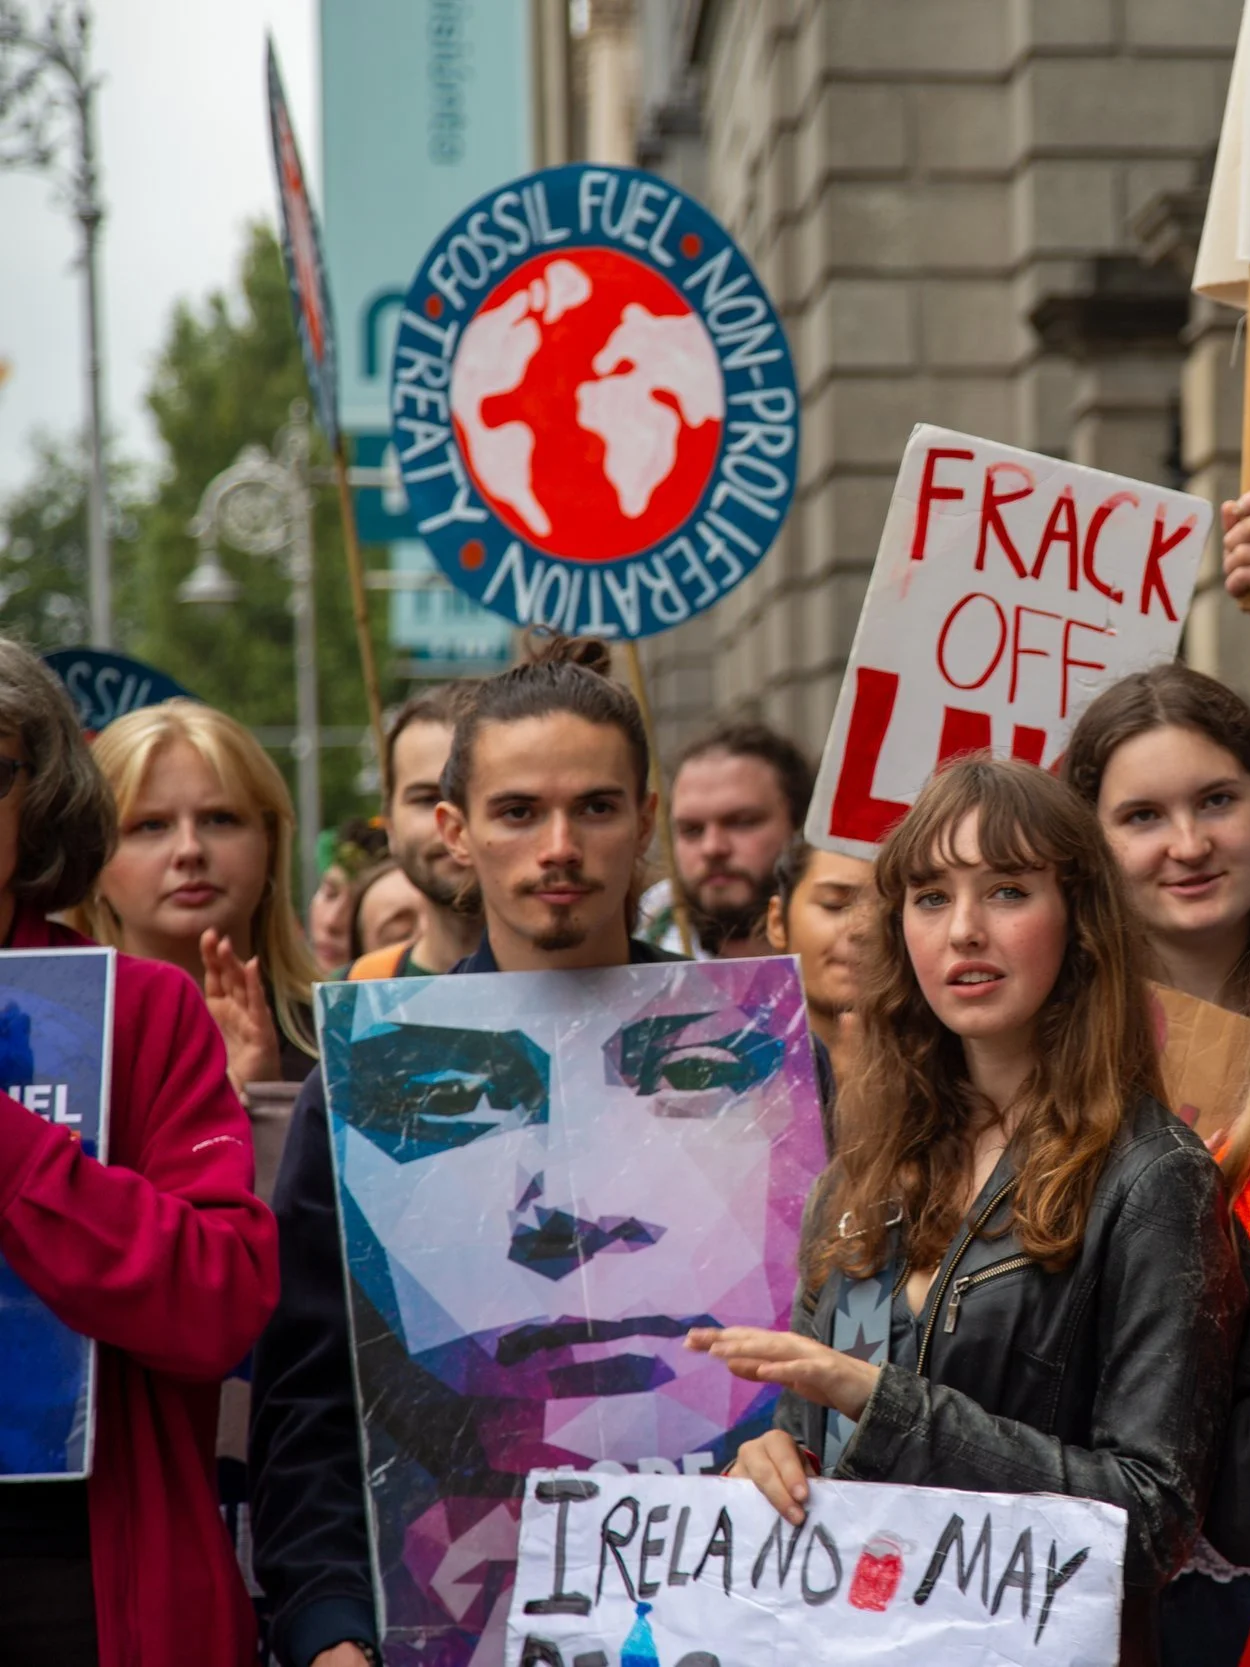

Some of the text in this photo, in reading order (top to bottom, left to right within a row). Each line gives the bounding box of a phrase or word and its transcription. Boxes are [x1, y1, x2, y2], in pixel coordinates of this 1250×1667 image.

[427, 181, 571, 311] FOSSIL
[578, 170, 683, 268] FUEL
[393, 309, 490, 535] TREATY
[482, 247, 796, 637] NON-PROLIFERATION
[911, 448, 1198, 622] FRACK
[936, 592, 1117, 719] OFF
[523, 1478, 1092, 1646] IRELAND MAY
